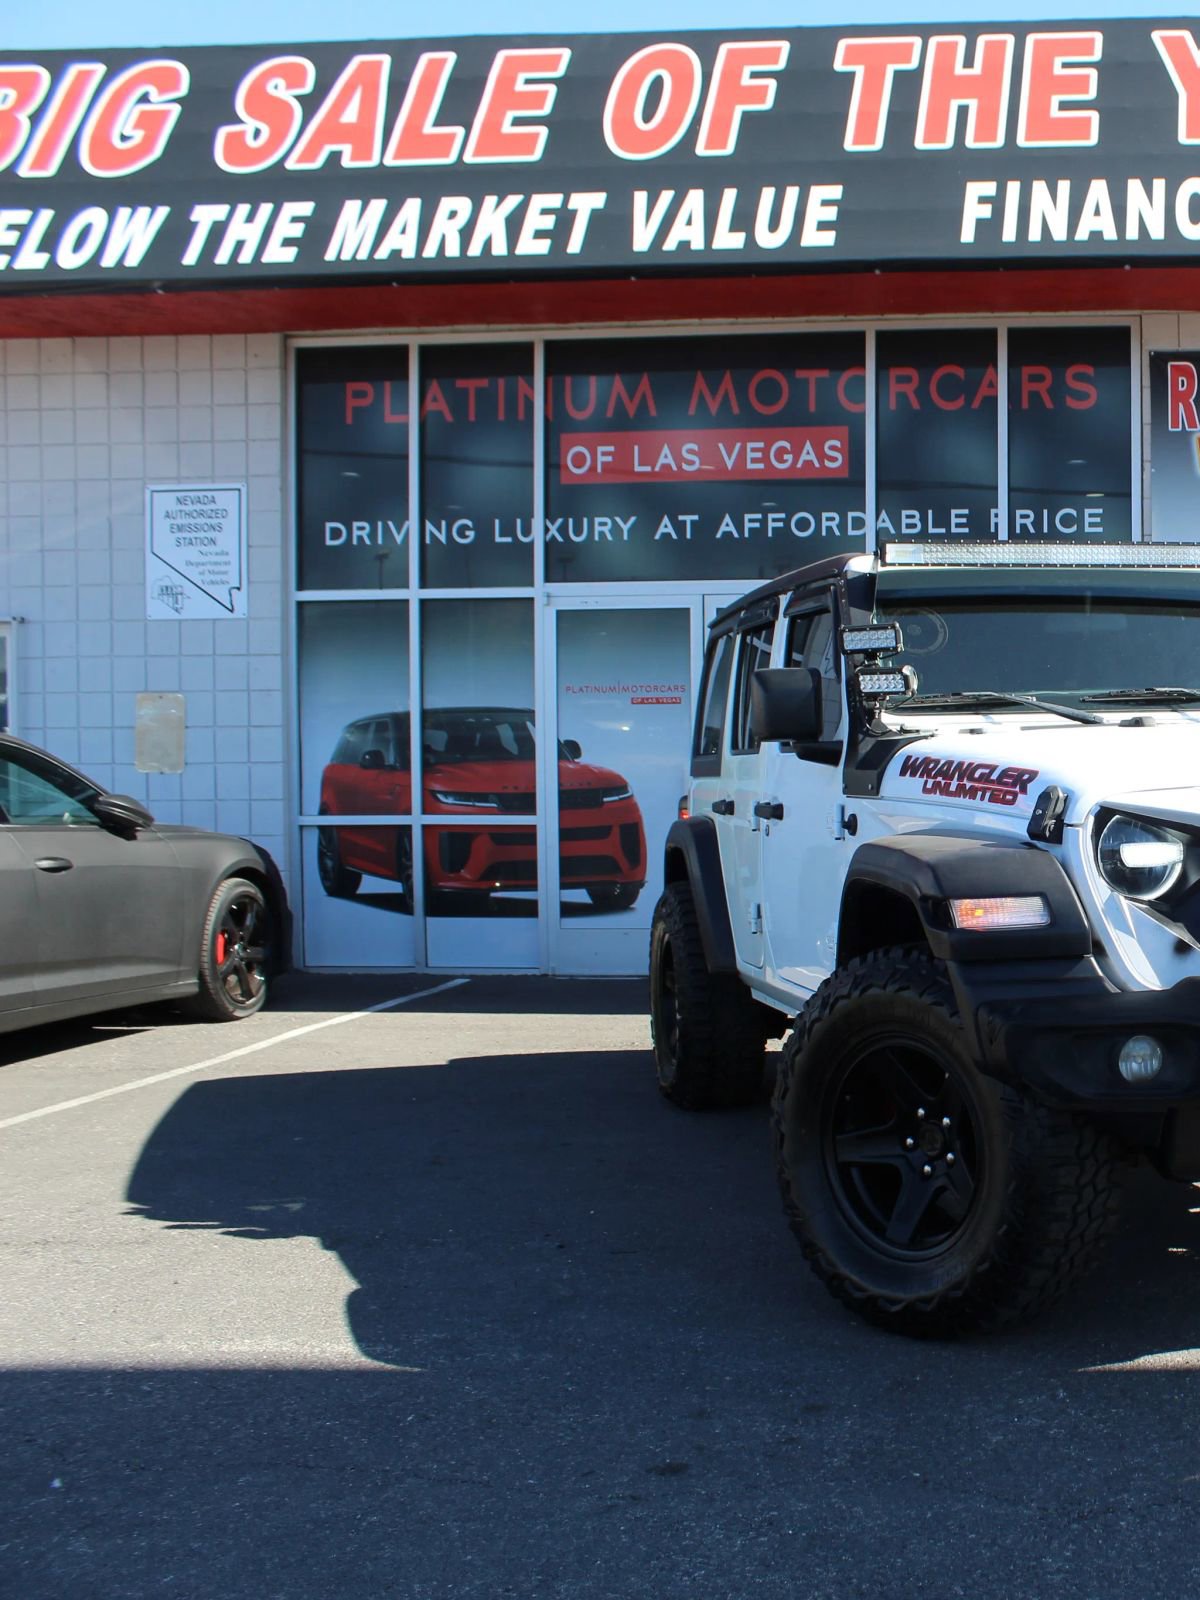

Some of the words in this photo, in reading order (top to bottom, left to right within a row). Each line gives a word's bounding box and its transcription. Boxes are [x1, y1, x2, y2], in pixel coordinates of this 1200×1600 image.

[213, 48, 572, 174] SALE
[603, 41, 791, 161] OF
[833, 31, 1103, 152] THE
[180, 201, 315, 267] THE
[324, 192, 607, 261] MARKET
[631, 184, 844, 253] VALUE
[344, 372, 658, 425] PLATINUM
[687, 364, 1099, 416] MOTORCARS
[566, 445, 615, 475] OF
[633, 442, 700, 473] LAS
[718, 439, 844, 471] VEGAS
[164, 508, 229, 520] AUTHORIZED
[175, 495, 217, 506] NEVADA
[169, 522, 224, 534] EMISSIONS
[175, 536, 217, 548] STATION
[324, 518, 476, 546] DRIVNG
[494, 515, 638, 543] LUXURY
[653, 513, 700, 540] AT
[715, 508, 970, 539] AFFORDABLE
[565, 685, 618, 694] PLATINUM
[621, 684, 686, 693] MOTORCARS
[899, 754, 1040, 796] WRANGLER
[921, 779, 1020, 806] UNLIMITED
